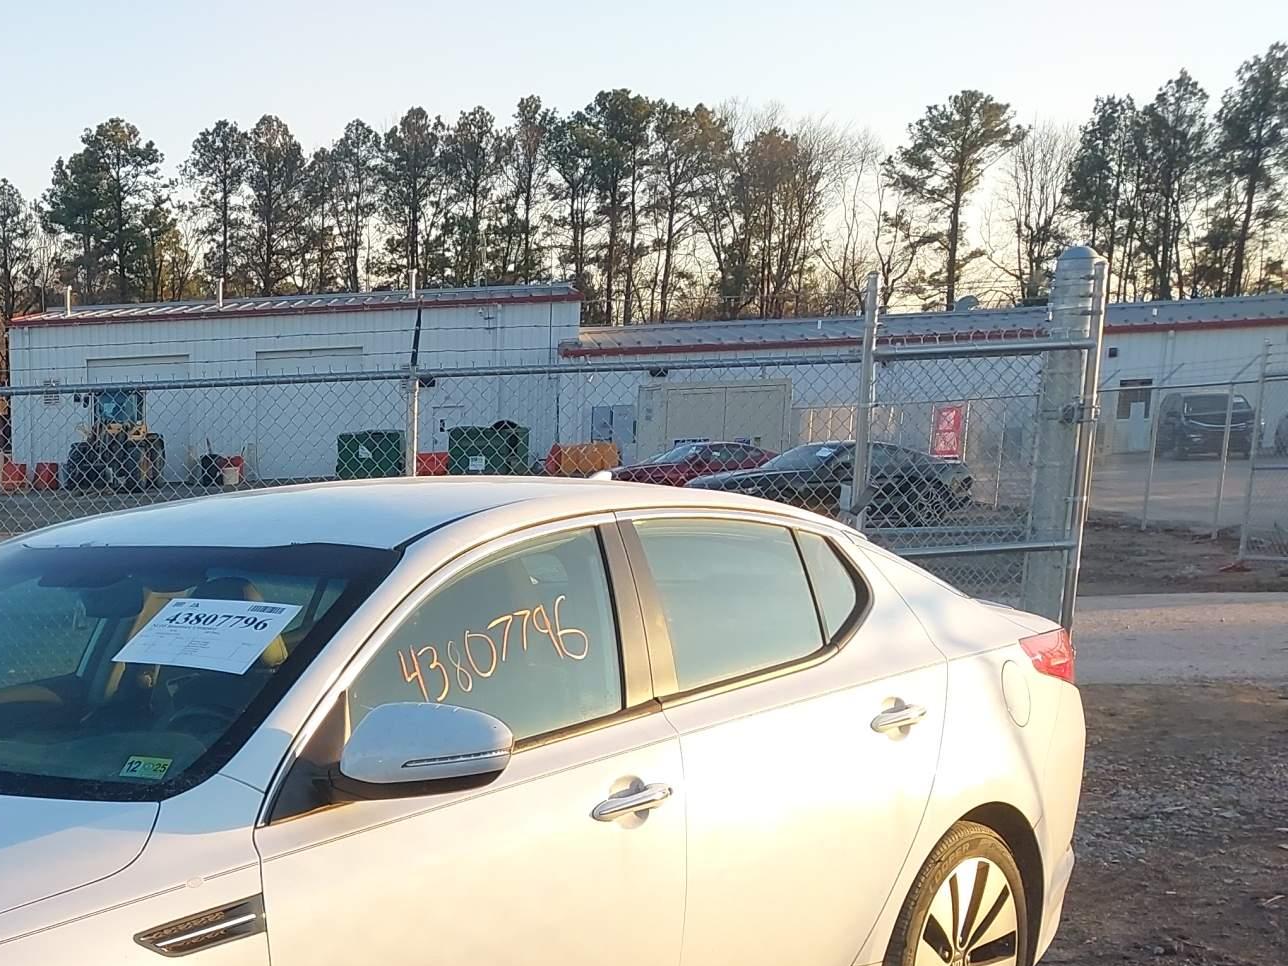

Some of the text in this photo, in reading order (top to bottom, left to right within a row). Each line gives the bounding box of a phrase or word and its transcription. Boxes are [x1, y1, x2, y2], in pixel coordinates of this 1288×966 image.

[165, 611, 272, 631] 43807796
[397, 594, 589, 702] 43807796
[127, 760, 168, 773] 12 25
